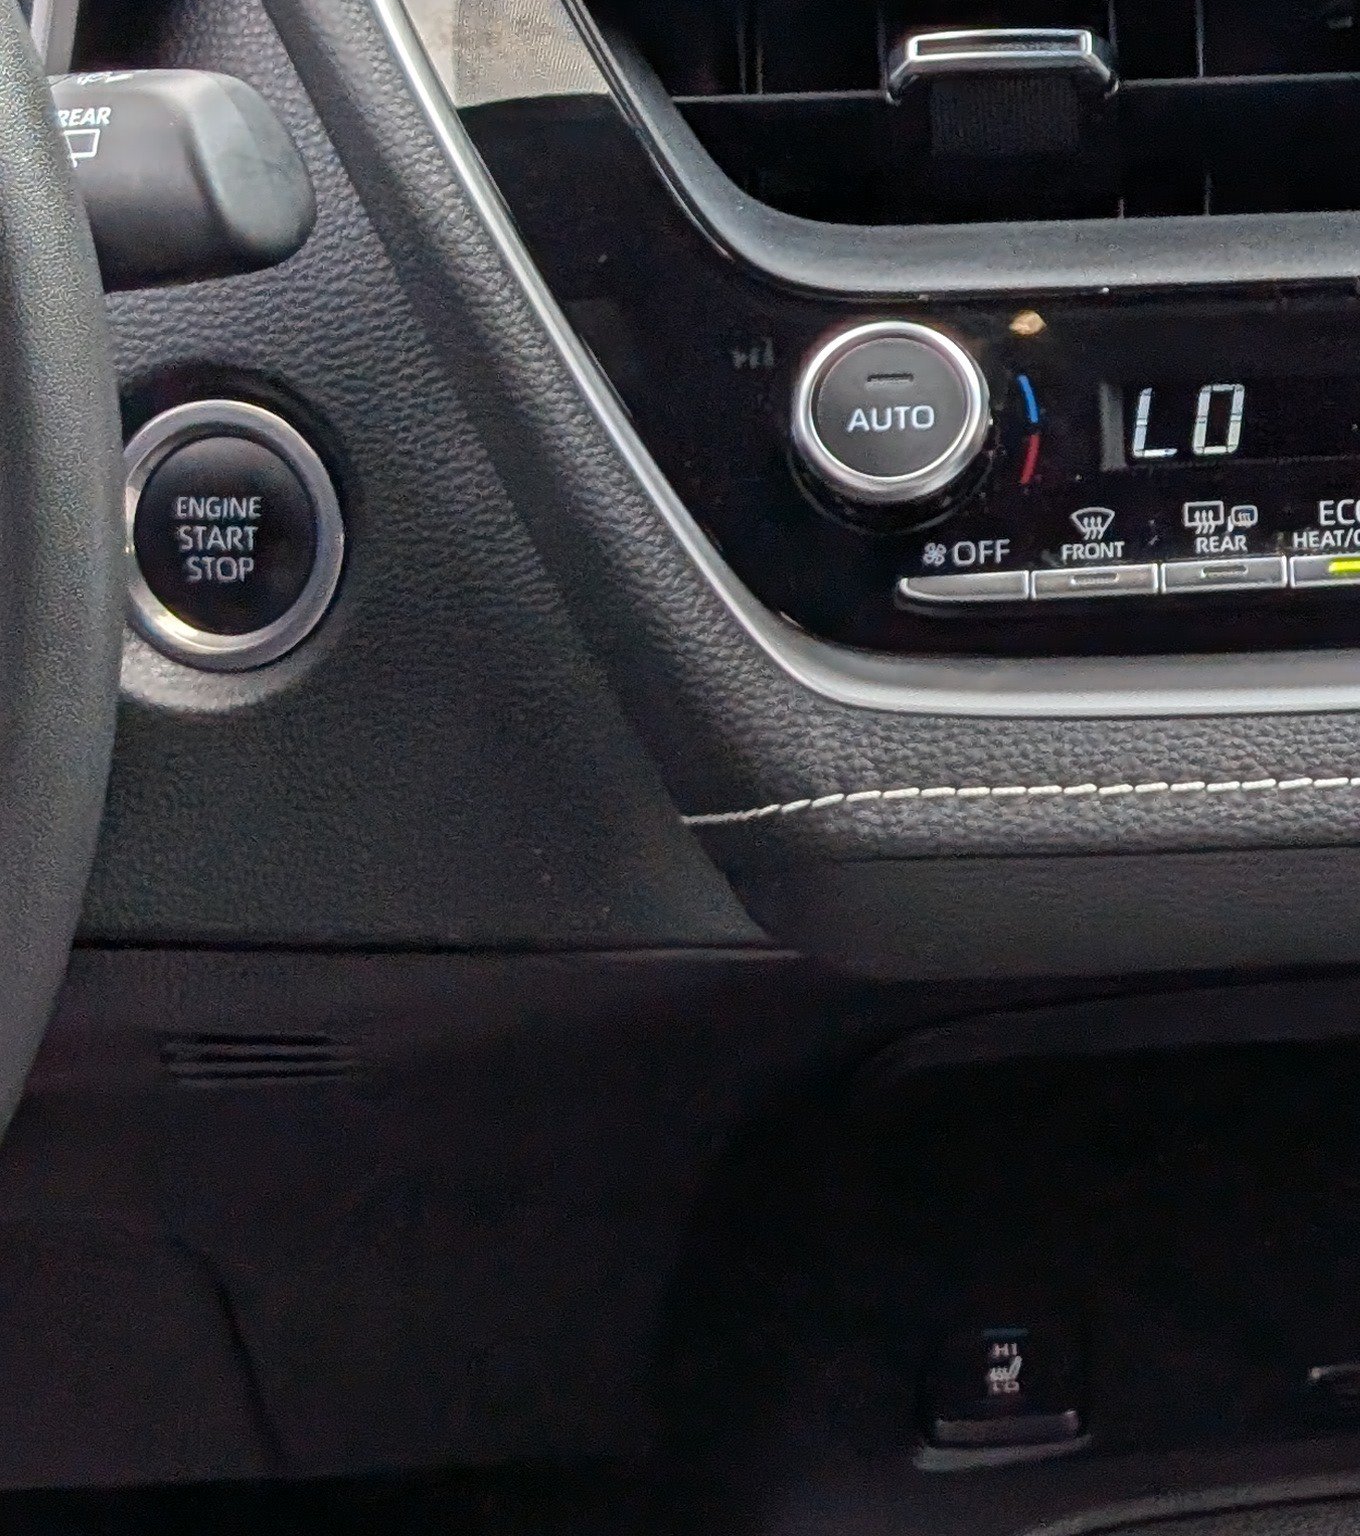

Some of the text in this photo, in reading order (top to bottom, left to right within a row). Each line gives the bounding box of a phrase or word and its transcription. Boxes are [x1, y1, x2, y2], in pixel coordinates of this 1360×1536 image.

[57, 106, 112, 128] REAR
[846, 405, 935, 433] AUTO
[1131, 383, 1246, 458] LO
[175, 496, 263, 519] ENGINE
[177, 526, 259, 551] START
[1061, 540, 1126, 560] FRONT
[1195, 534, 1249, 554] REAR
[951, 538, 1011, 565] OFF
[185, 556, 255, 583] STOP
[991, 1342, 1018, 1357] HI
